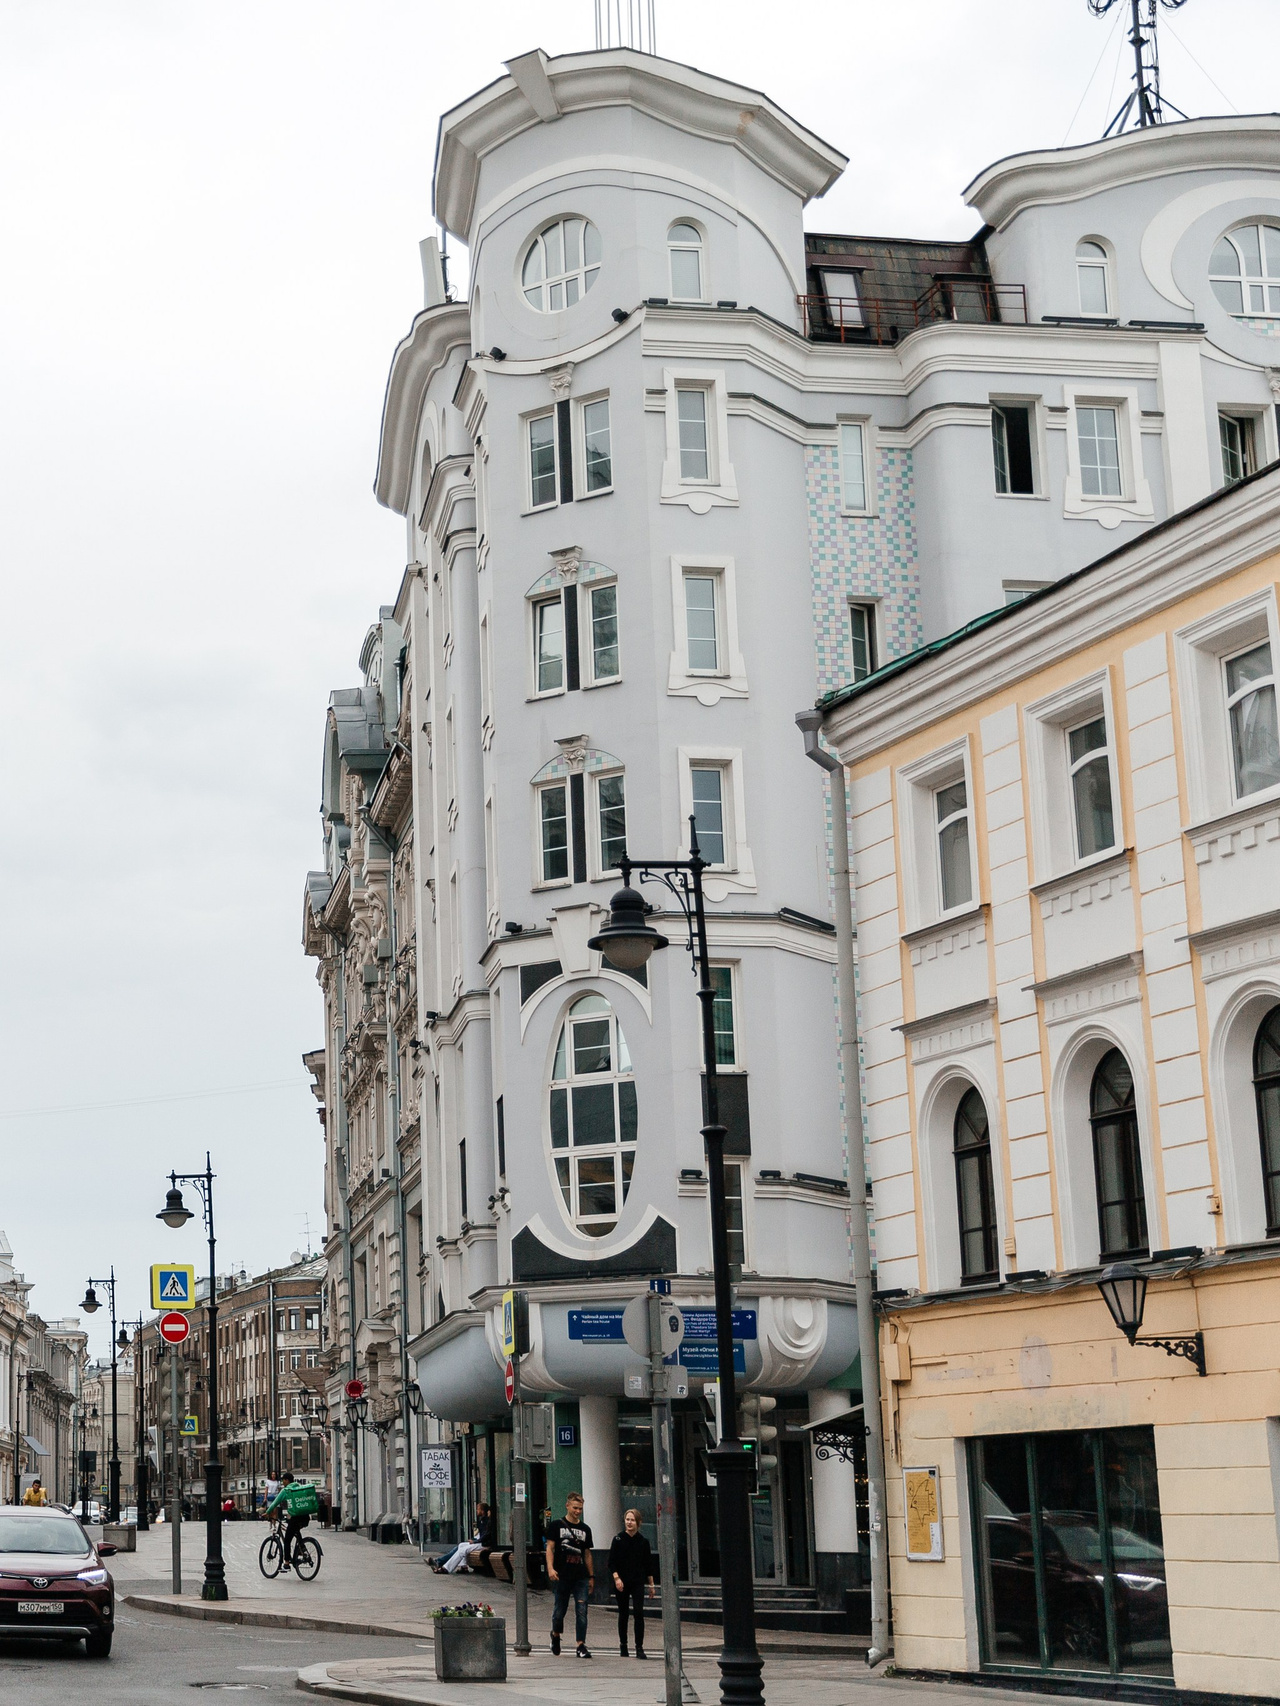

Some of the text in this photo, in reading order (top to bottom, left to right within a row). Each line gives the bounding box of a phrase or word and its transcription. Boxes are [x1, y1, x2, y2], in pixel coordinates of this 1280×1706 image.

[561, 1430, 571, 1441] 16
[423, 1451, 449, 1461] ТАБАК
[423, 1471, 450, 1480] КОФЕ
[295, 1495, 316, 1503] Delivery
